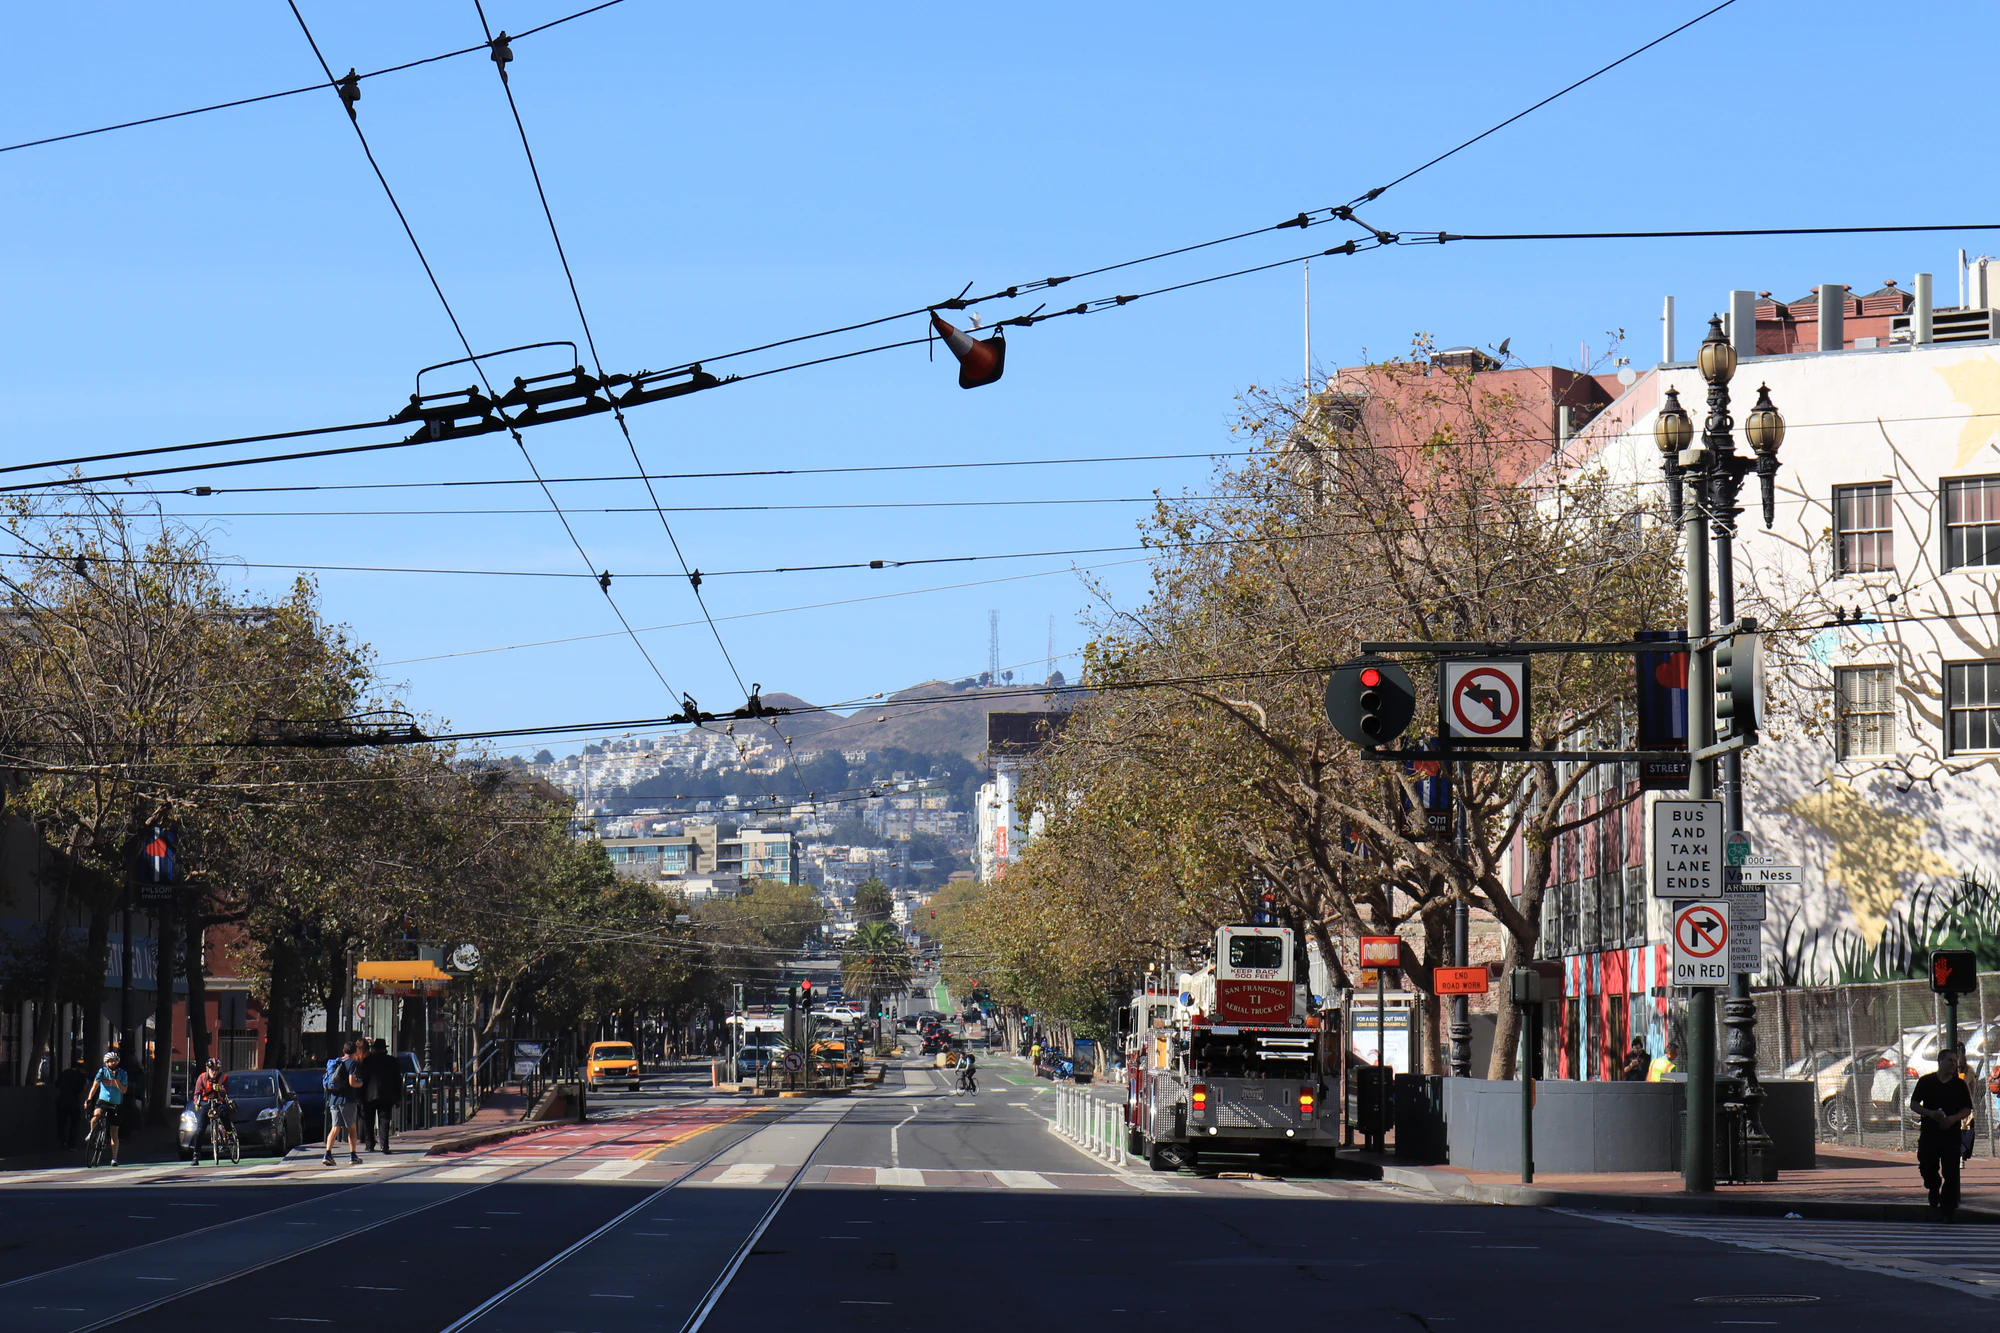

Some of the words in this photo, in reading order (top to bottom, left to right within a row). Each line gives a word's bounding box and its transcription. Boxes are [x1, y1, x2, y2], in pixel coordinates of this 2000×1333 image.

[1649, 764, 1686, 773] STREET
[1673, 811, 1704, 822] BUS
[1672, 828, 1705, 838] AND
[1670, 844, 1708, 855] TAXI
[1666, 861, 1710, 872] LANE
[1728, 870, 1752, 880] Van
[1760, 870, 1792, 880] Ness
[1667, 878, 1710, 888] ENDS
[1678, 964, 1695, 978] ON
[1700, 964, 1725, 978] RED
[1225, 987, 1240, 995] SAN
[1242, 985, 1285, 996] FRANCISCO
[1225, 1002, 1249, 1014] AERIAL
